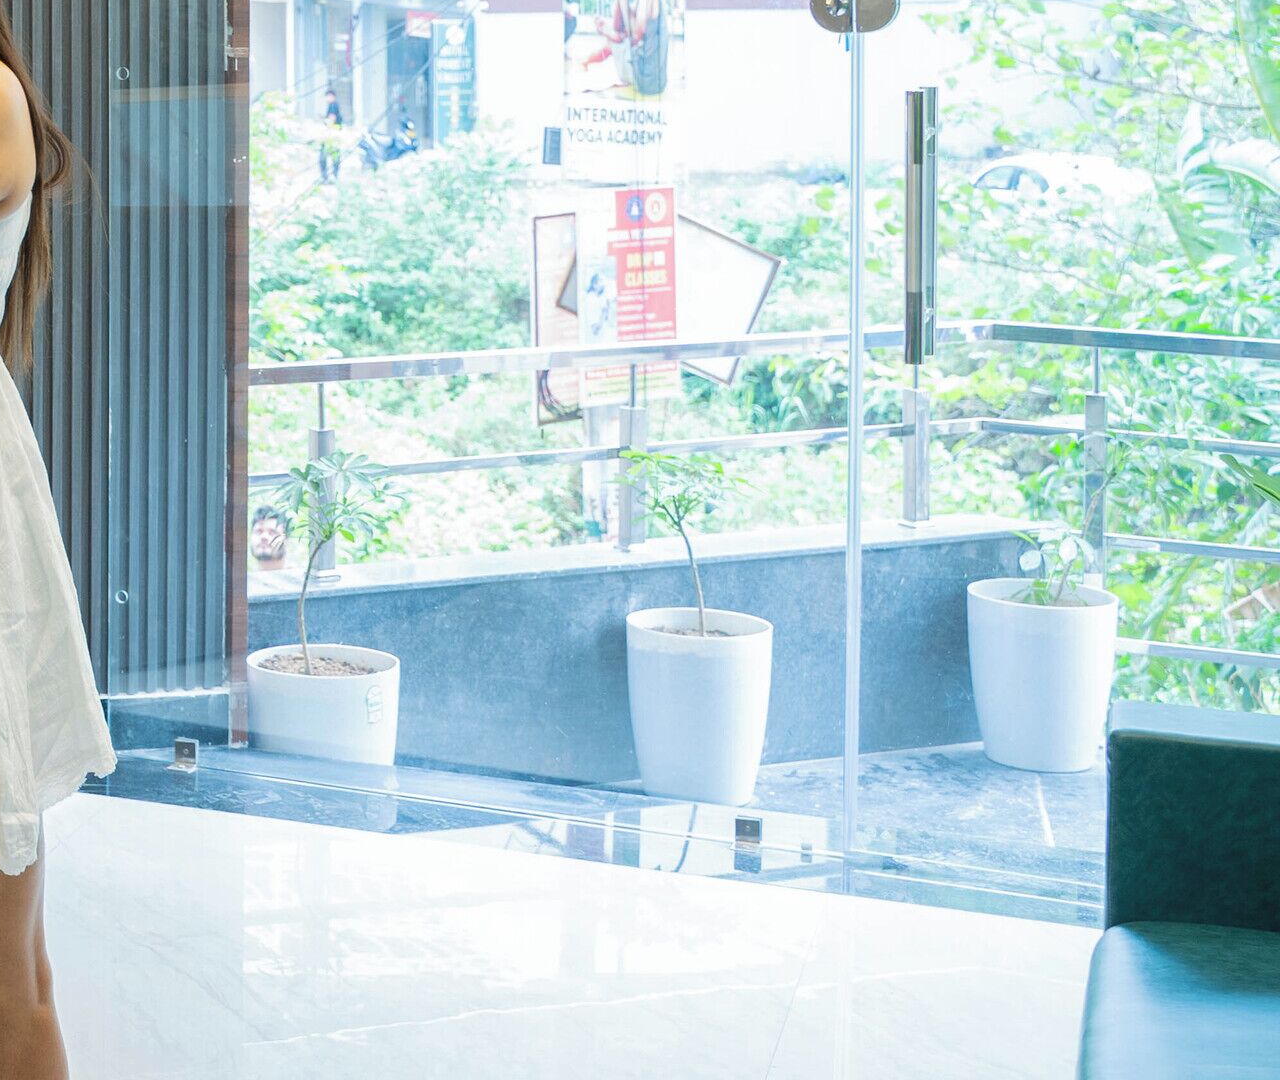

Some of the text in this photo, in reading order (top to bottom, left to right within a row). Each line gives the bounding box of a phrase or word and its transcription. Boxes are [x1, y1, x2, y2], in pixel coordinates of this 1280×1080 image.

[567, 107, 667, 126] INTERNATIONAL
[567, 127, 664, 145] YOGA ACADEMY
